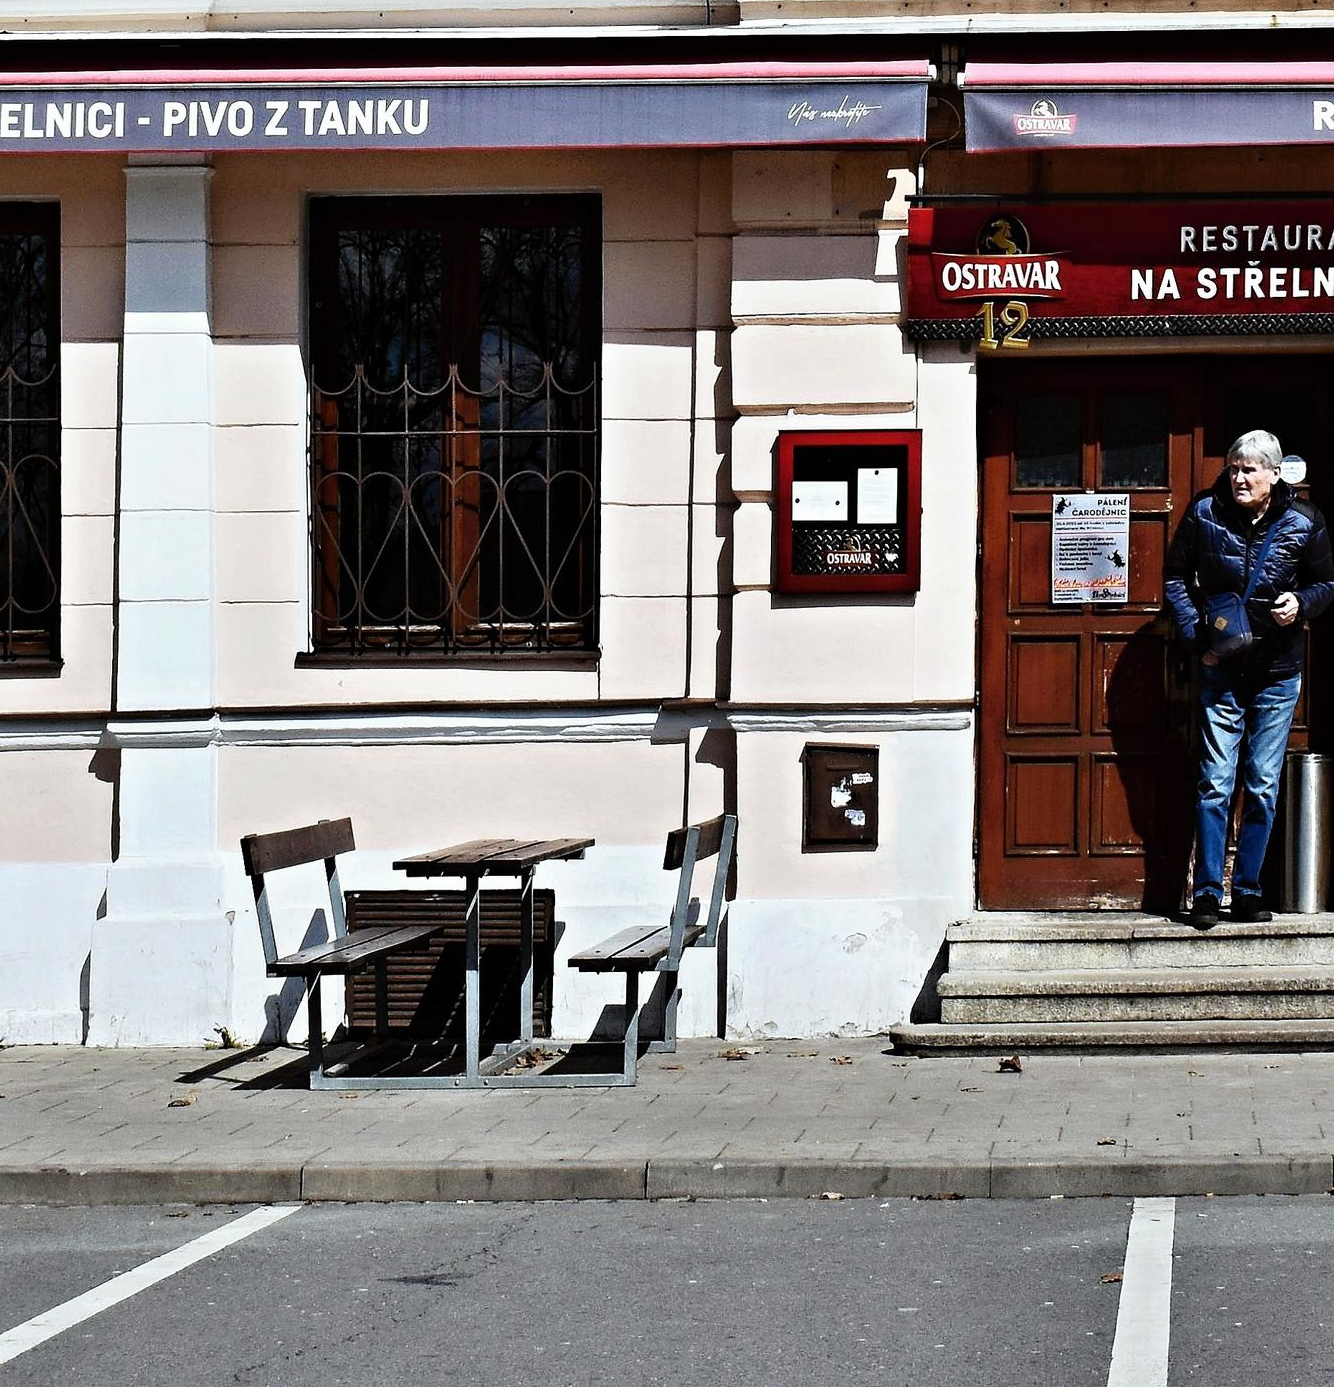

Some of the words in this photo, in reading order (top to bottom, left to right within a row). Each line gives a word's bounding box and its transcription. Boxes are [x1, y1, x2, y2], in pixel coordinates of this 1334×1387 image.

[163, 100, 254, 137] PIVO
[264, 100, 289, 136] Z
[298, 97, 429, 136] TANKU
[1017, 118, 1071, 131] OSTRAVAR
[942, 259, 1062, 293] OSTRAVAR
[1130, 268, 1181, 301] NA
[975, 301, 1031, 351] 12
[1071, 507, 1127, 517] ČARODĚJNIC
[1097, 496, 1128, 506] PÁLENÍ
[826, 552, 873, 565] OSTRAVAR
